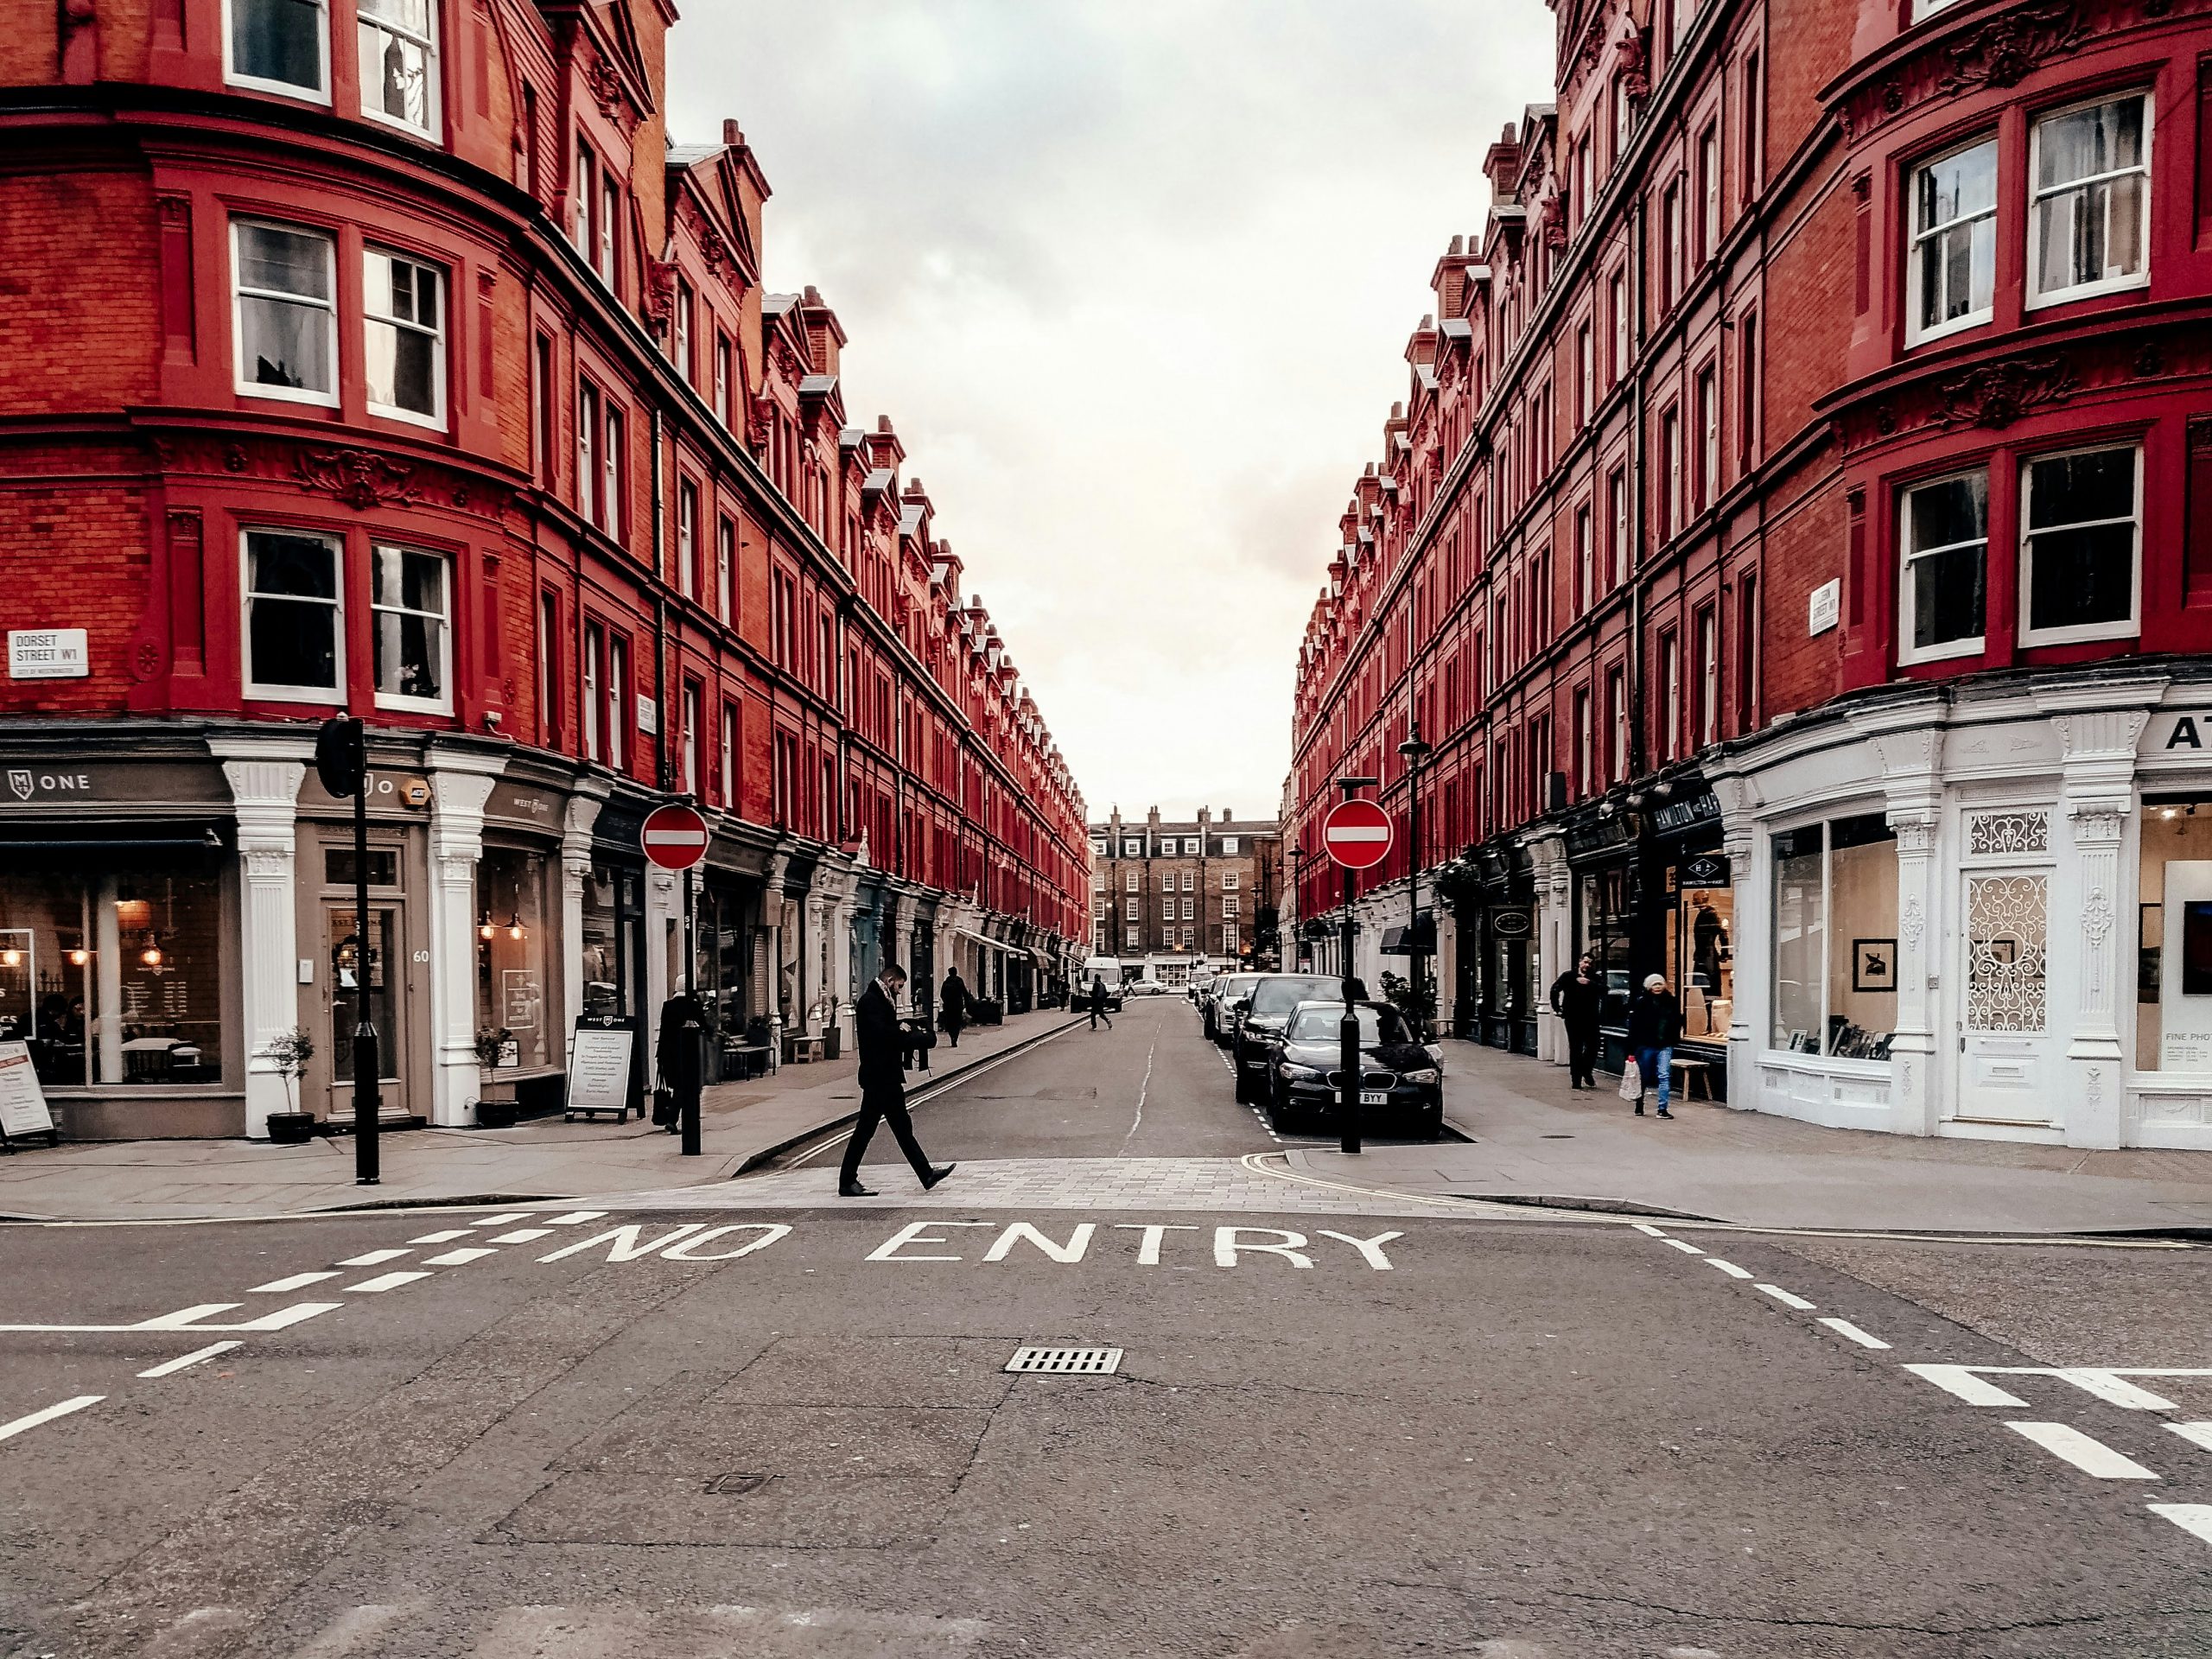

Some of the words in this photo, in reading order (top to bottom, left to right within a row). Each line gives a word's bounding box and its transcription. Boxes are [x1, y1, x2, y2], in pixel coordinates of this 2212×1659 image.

[16, 635, 56, 646] DORSET
[16, 649, 55, 661] STREET
[61, 649, 77, 659] W1
[40, 775, 90, 790] ONE
[684, 915, 690, 930] S4
[413, 950, 429, 963] 60
[2165, 1033, 2188, 1041] FINE
[2190, 1033, 2212, 1041] PHO
[1363, 1094, 1383, 1103] BYY
[534, 1223, 794, 1265] NO
[863, 1221, 1406, 1271] ENTRY
